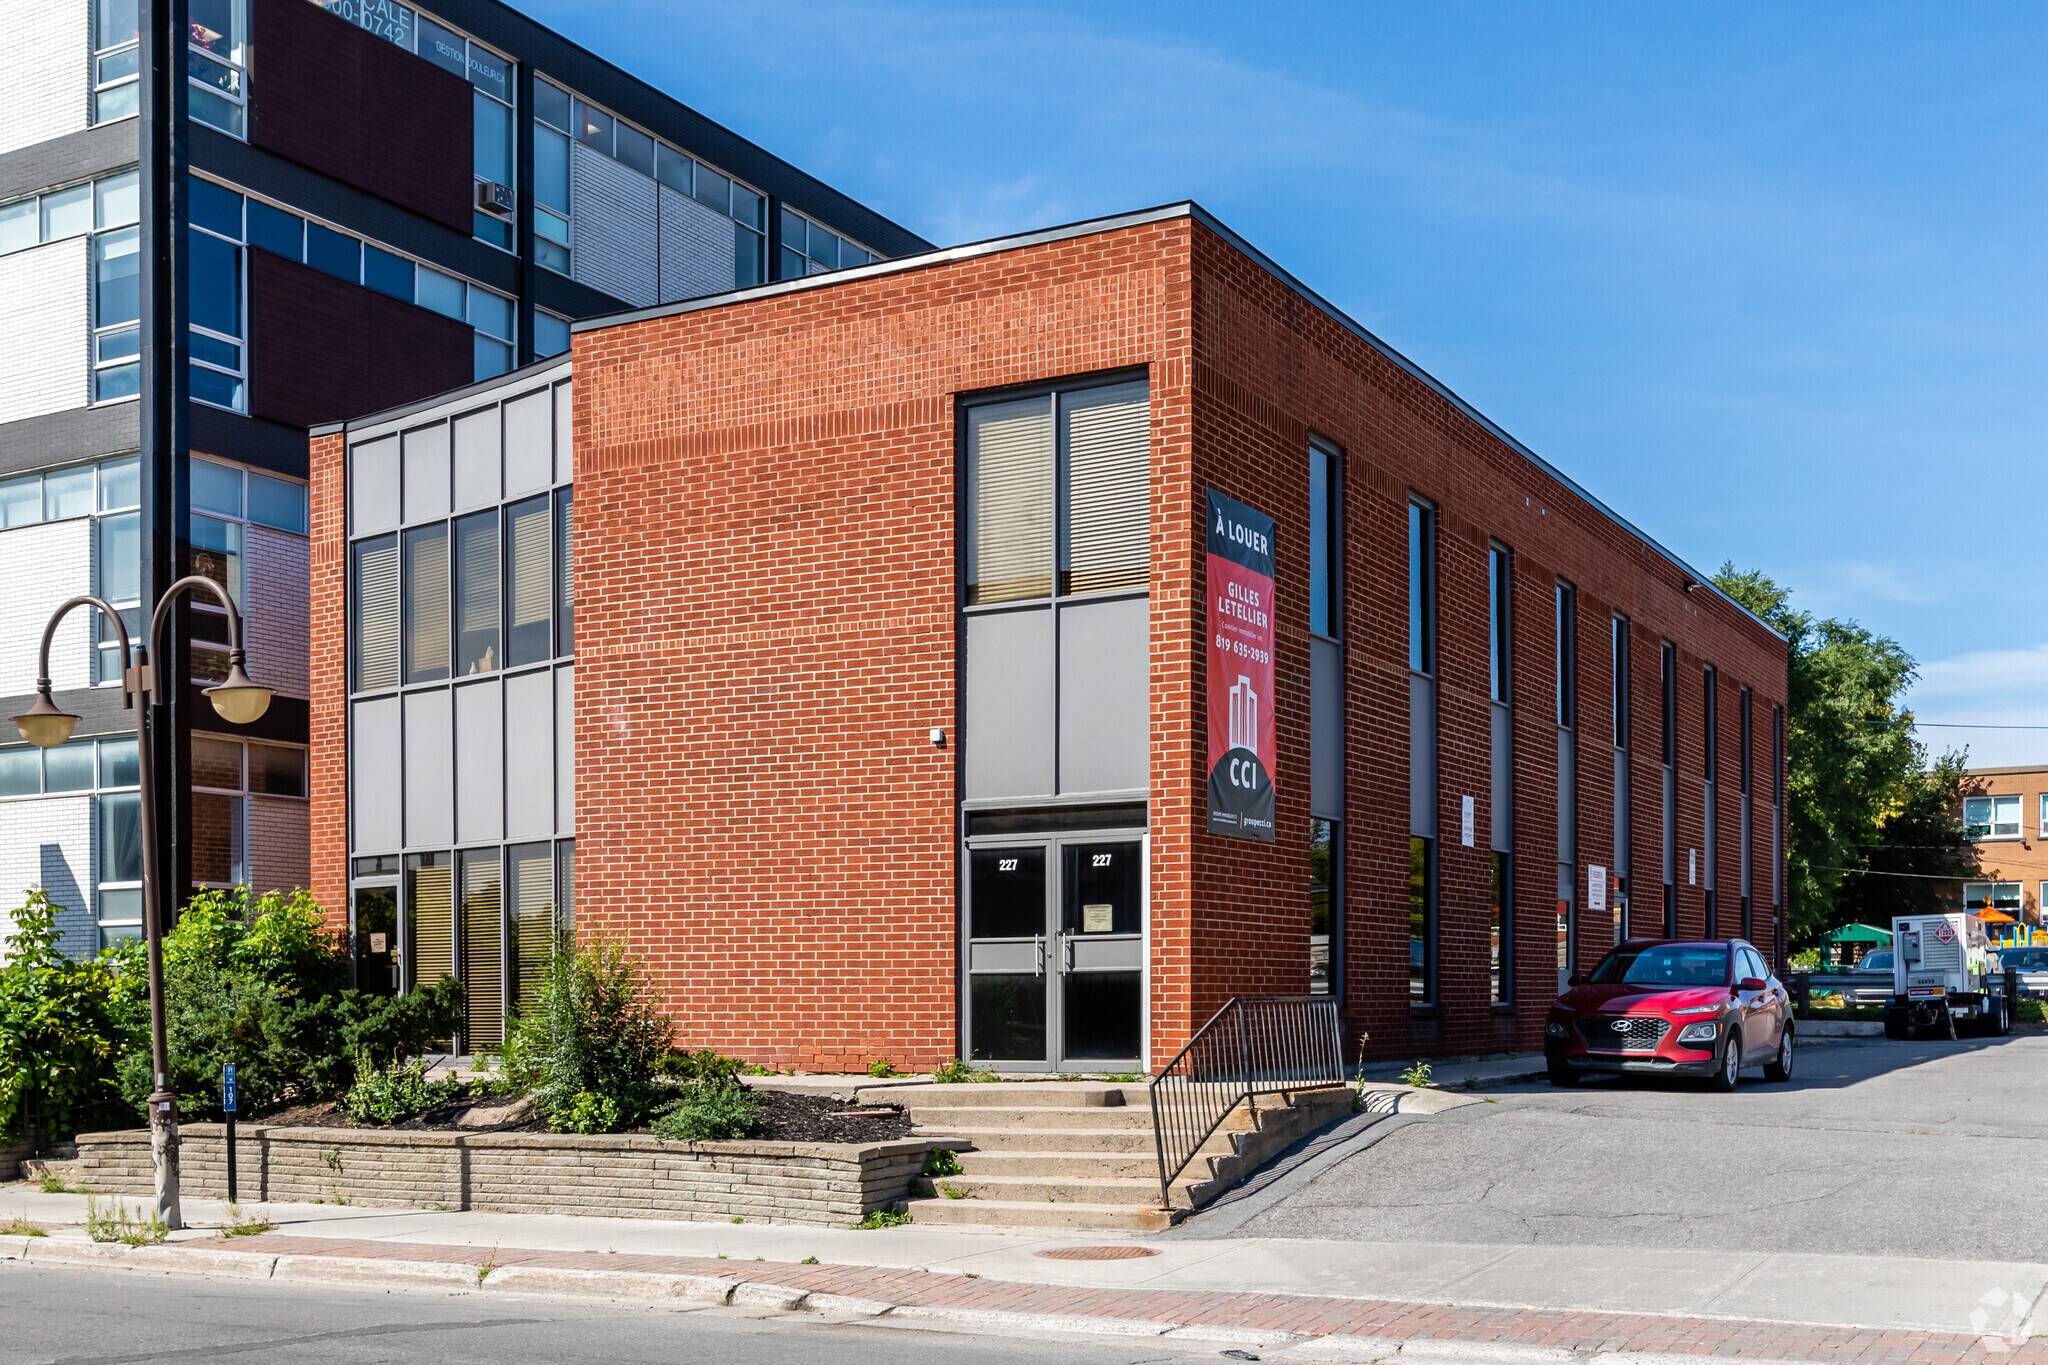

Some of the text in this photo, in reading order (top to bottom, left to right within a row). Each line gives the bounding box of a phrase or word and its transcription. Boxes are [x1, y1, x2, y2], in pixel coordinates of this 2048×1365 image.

[1215, 508, 1268, 556] À LOUER
[1228, 581, 1260, 608] GILLES
[1218, 596, 1268, 629] LETELLIER
[1215, 633, 1269, 665] 819 635-2939
[1229, 757, 1257, 790] CCI
[1243, 817, 1272, 828] groupecci.ca
[999, 859, 1018, 871] 227
[1092, 854, 1112, 867] 227
